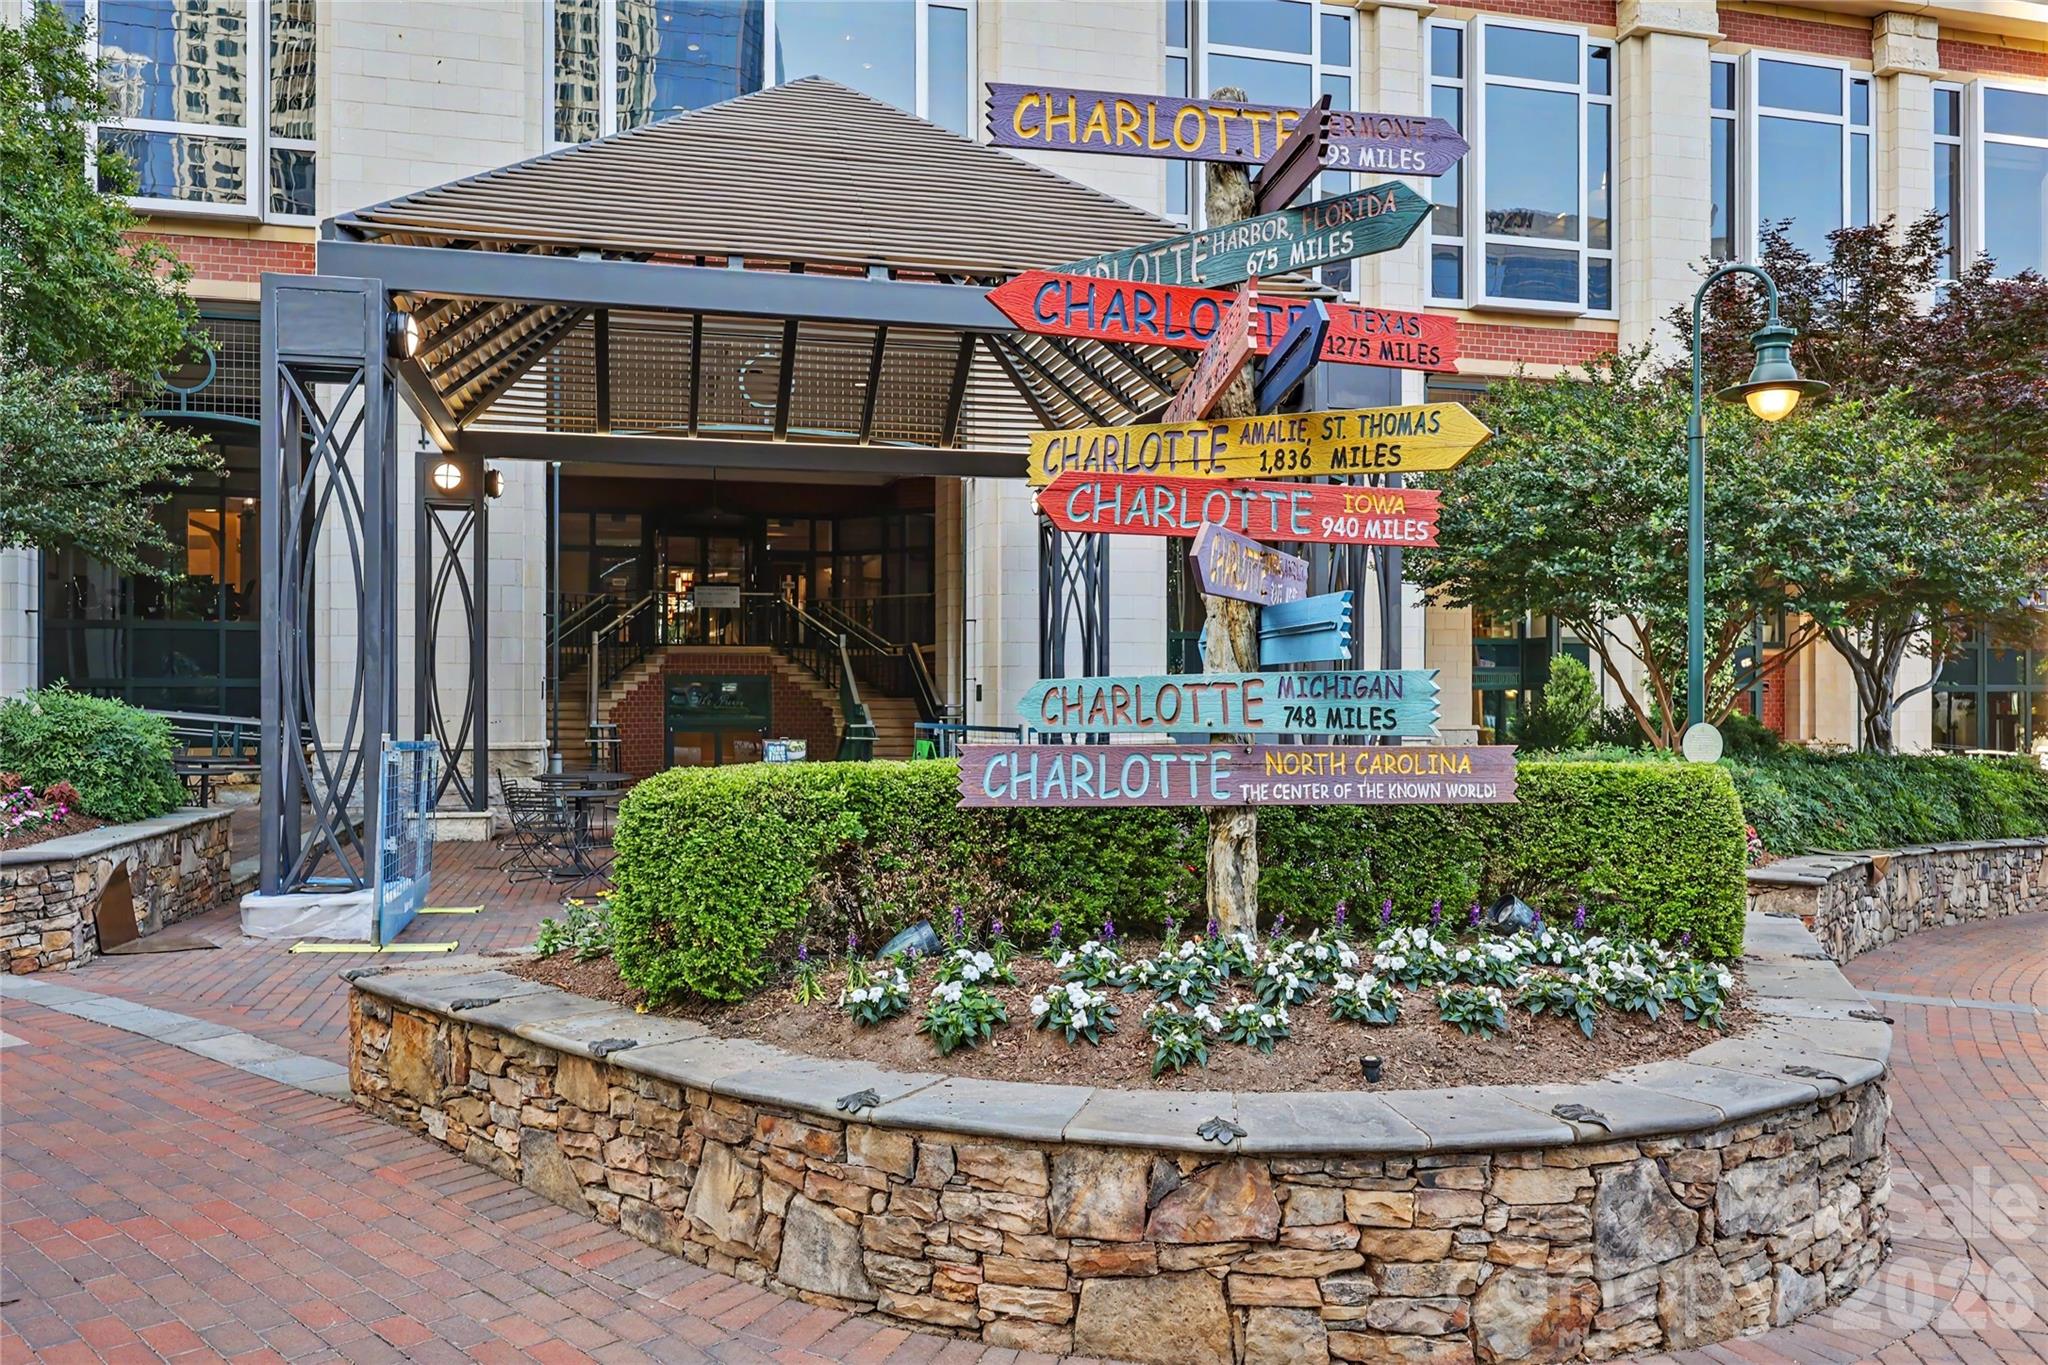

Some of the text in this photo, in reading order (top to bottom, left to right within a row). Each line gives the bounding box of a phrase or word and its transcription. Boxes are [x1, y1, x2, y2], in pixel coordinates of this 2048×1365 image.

[1013, 92, 1300, 158] CHARLOTTE
[1329, 113, 1426, 143] ERMONT
[1359, 146, 1426, 171] MILES
[1212, 188, 1397, 256] HARBOR, FLORIDA
[1246, 231, 1354, 275] 675 MILES
[1032, 279, 1308, 347] CHARLOT
[1348, 308, 1421, 338] TEXAS
[1326, 335, 1440, 365] 1275 MILES
[1239, 411, 1441, 446] AMALIE, ST. THOMAS
[1042, 424, 1230, 475] CHARLOTTE
[1260, 443, 1402, 474] 1,836 MILES
[1066, 480, 1313, 535] CHARLOTTE
[1343, 493, 1406, 515] IOWA
[1321, 516, 1430, 541] 940 MILES
[1277, 675, 1403, 700] MICHIGAN
[1041, 678, 1265, 728] CHARLOTTE
[1284, 706, 1398, 731] 748 MILES
[983, 751, 1232, 800] CHARLOTTE
[1265, 751, 1472, 776] NORTH CAROLINA
[1239, 782, 1497, 801] THE CENTER OF THE KNOWN WORLD!
